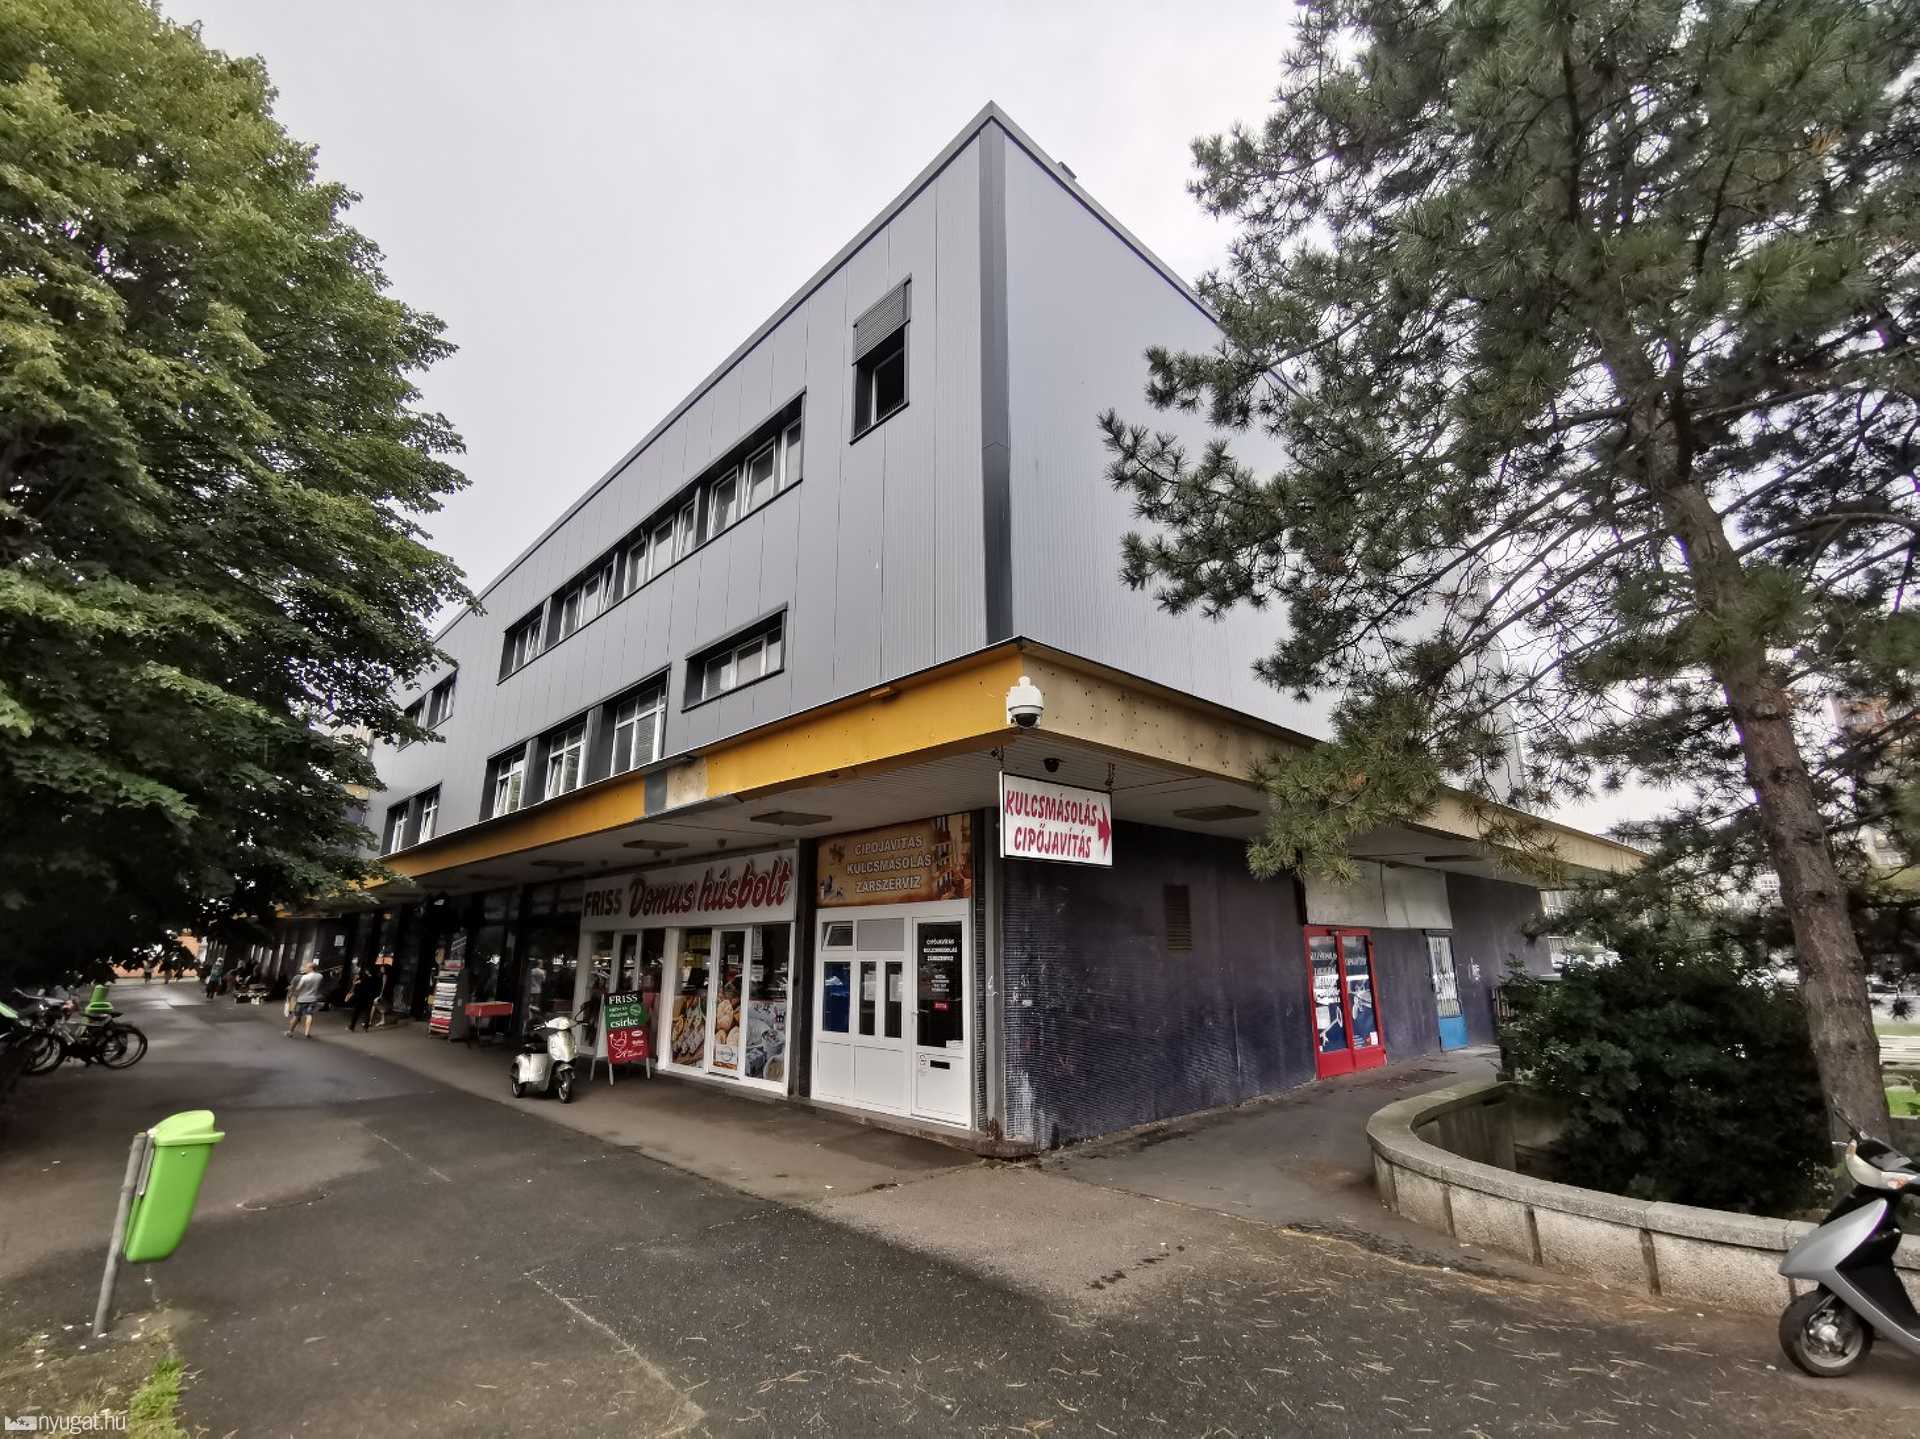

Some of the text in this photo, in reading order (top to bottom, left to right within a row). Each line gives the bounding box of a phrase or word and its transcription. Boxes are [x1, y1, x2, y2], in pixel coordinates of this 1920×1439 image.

[1005, 789, 1097, 827] KULCSMÁSOLÁS
[1014, 822, 1092, 859] CIPŐJAVÍTÁS
[584, 858, 793, 918] FRISS Domus húsbolt
[610, 1017, 639, 1028] csirke
